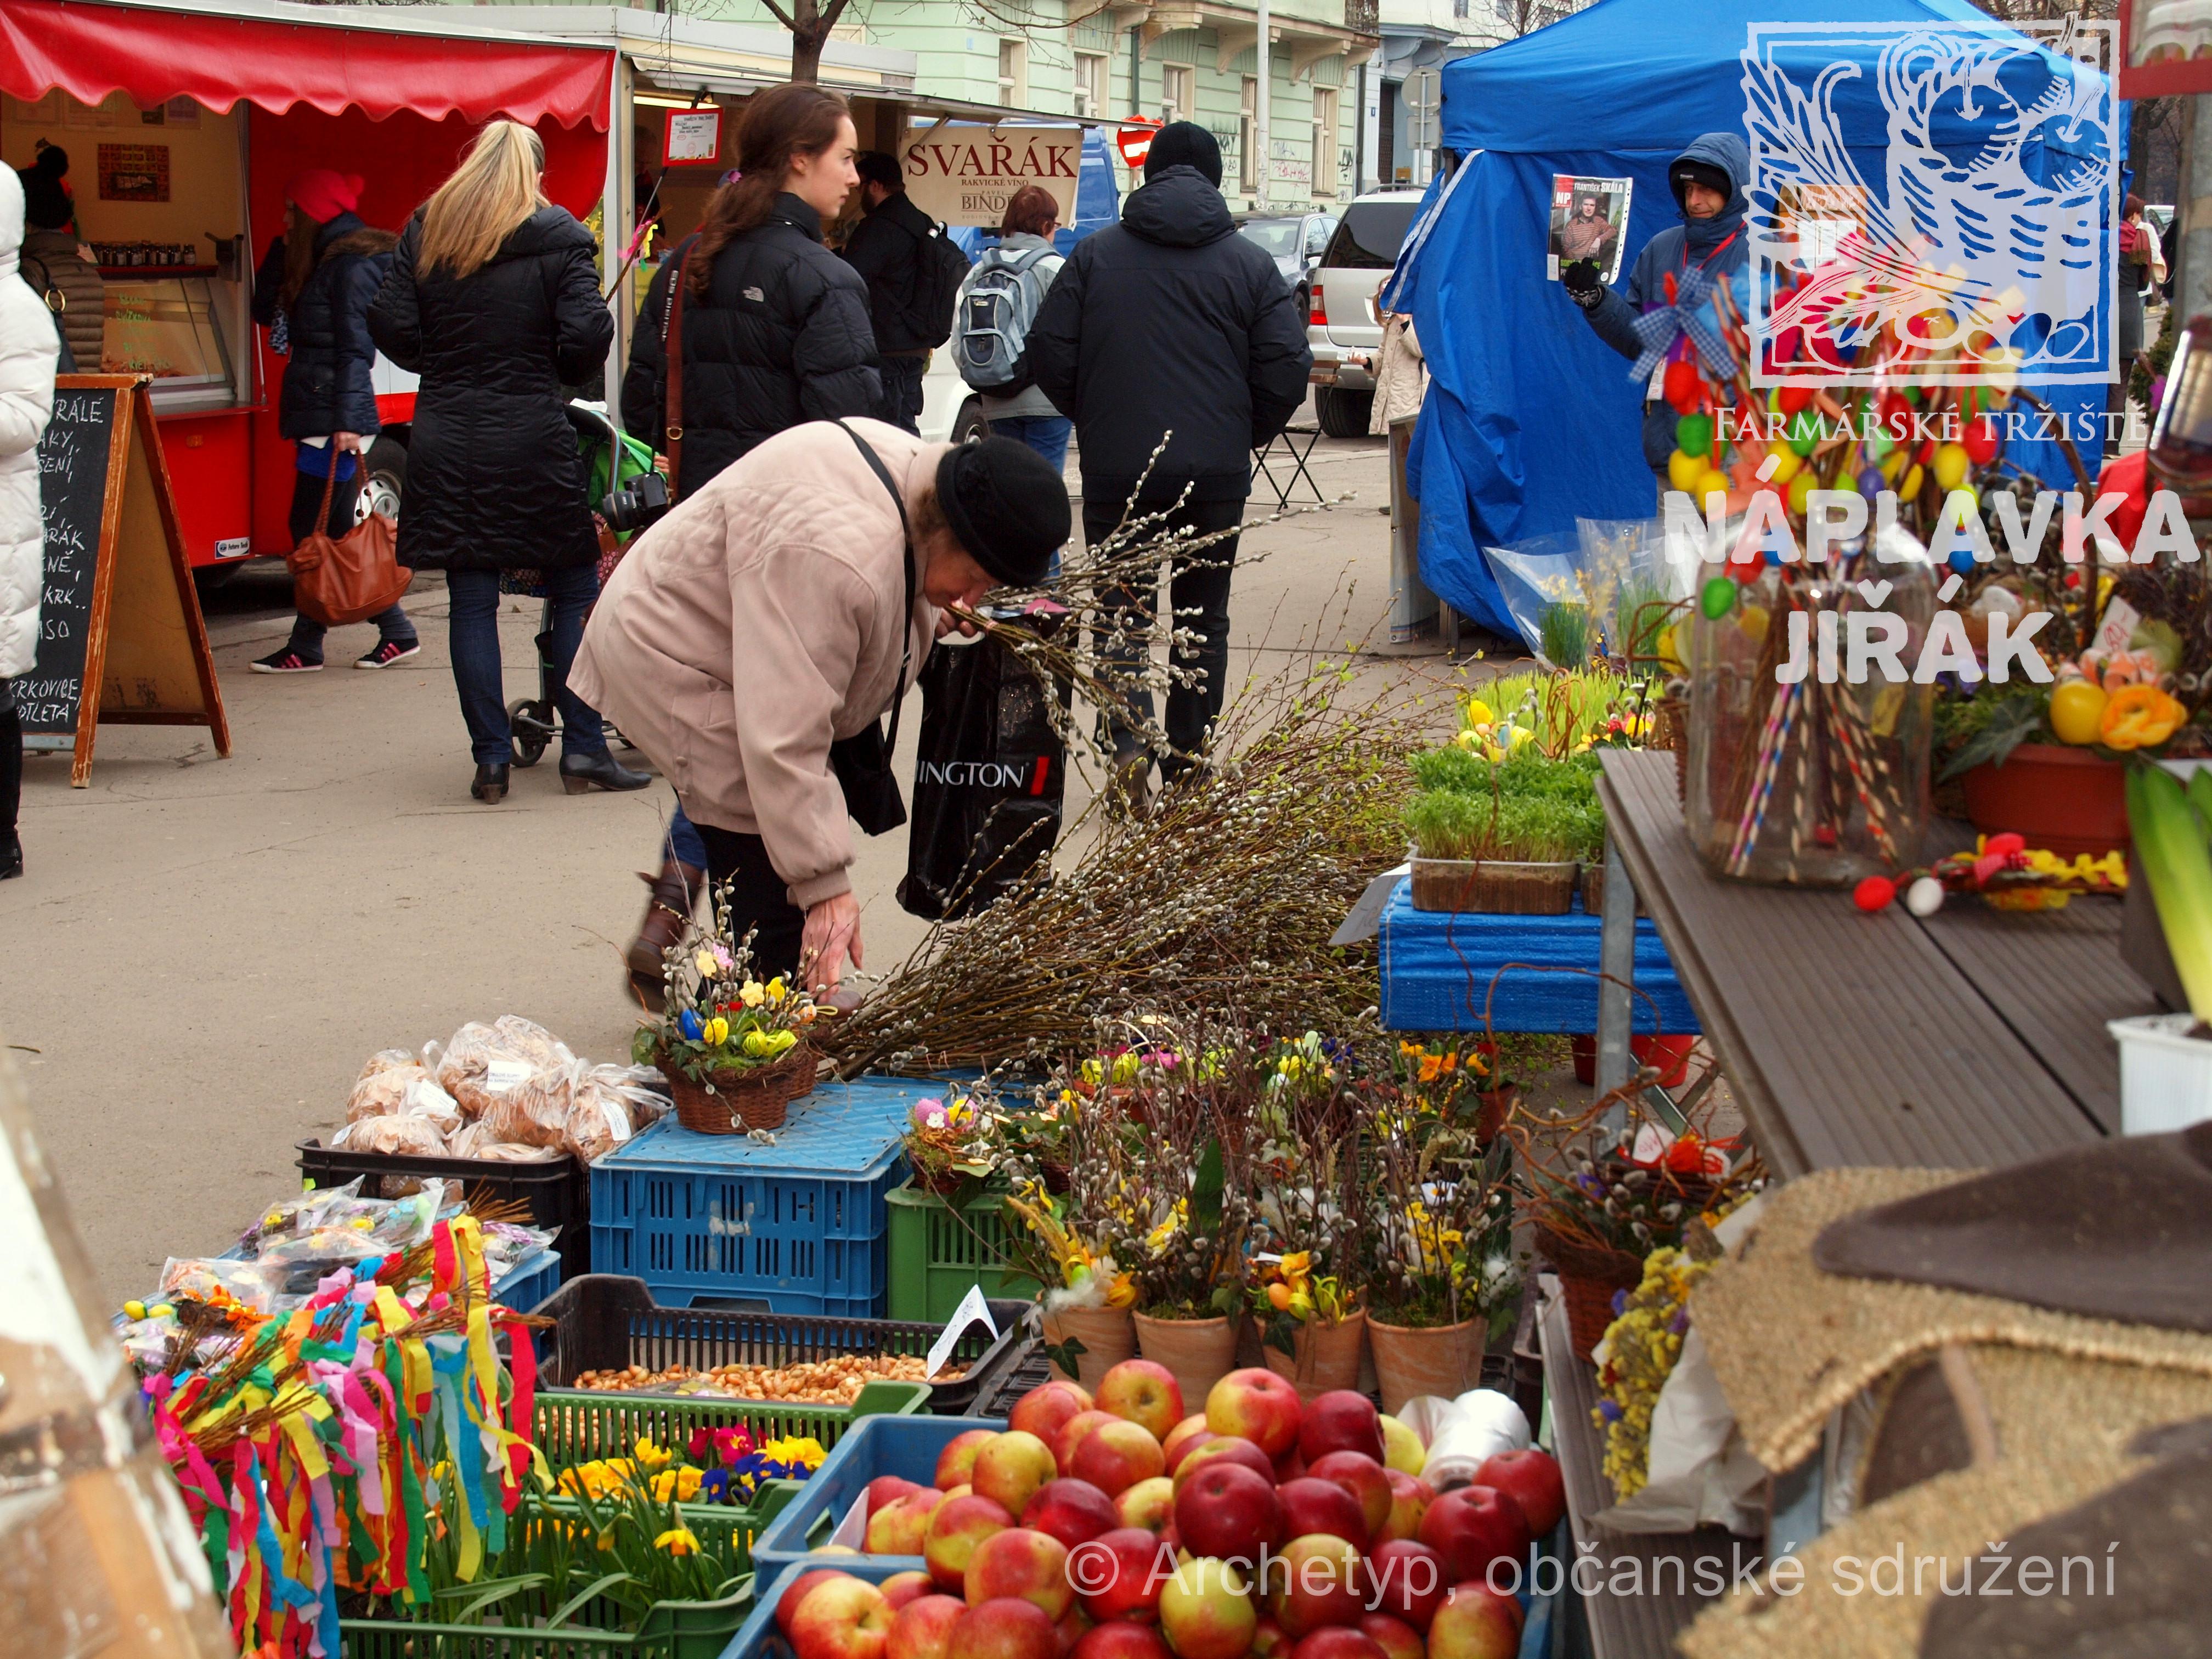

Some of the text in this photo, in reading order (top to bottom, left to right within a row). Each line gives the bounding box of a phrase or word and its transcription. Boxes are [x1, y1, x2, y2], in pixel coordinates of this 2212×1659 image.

[908, 136, 1077, 178] SVAŘÁK
[961, 178, 1029, 187] RAKVICKÉ VÍNO
[1600, 182, 1623, 194] SKÁLA
[1556, 192, 1571, 205] NP
[53, 396, 104, 424] RÁLÉ
[37, 447, 81, 484] ŠENÍ,
[37, 619, 70, 640] ASO
[16, 701, 69, 723] OTLETA
[915, 760, 1024, 788] INGTON
